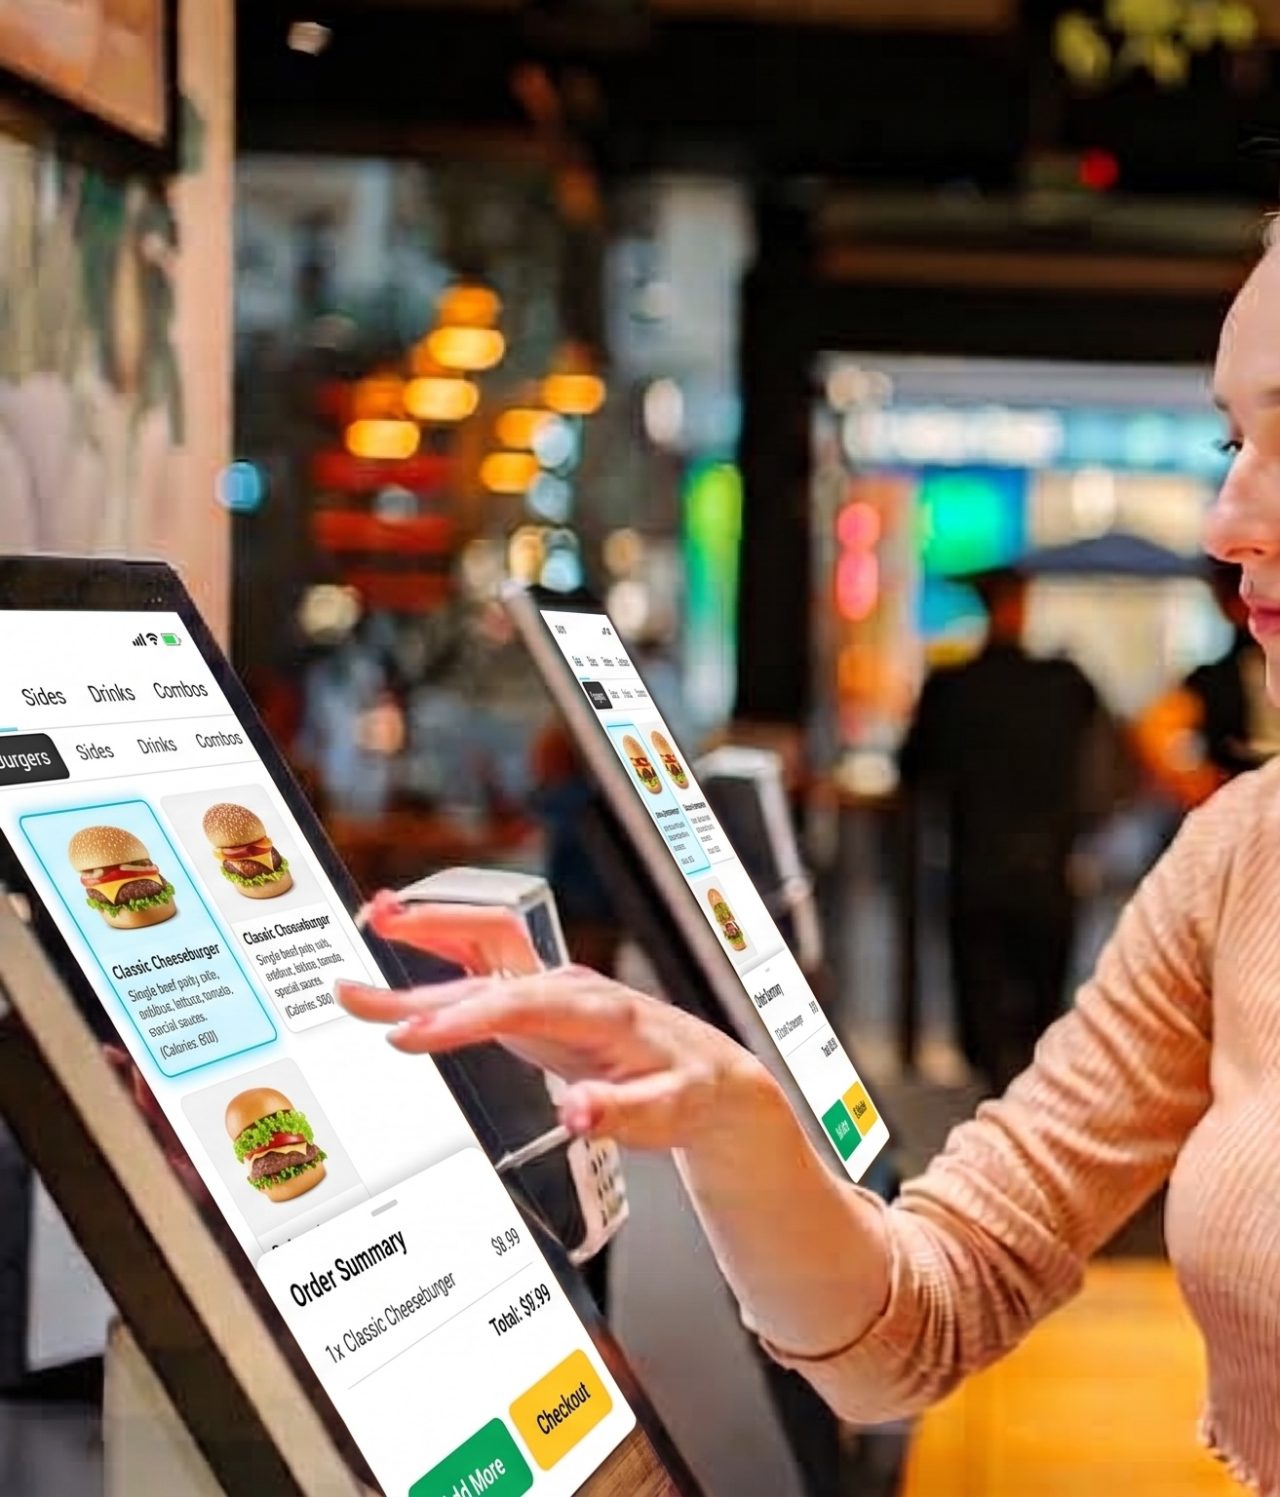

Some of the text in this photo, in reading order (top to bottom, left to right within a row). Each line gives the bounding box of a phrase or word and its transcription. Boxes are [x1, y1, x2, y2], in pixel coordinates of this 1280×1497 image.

[21, 680, 208, 706] Sides Drinks Combos
[76, 743, 115, 761] Sides
[137, 736, 178, 755] Drinks
[196, 731, 243, 749] Combos
[243, 927, 276, 945] Classic
[112, 944, 220, 980] Classic Cheeseburger
[128, 985, 158, 1002] Single
[491, 1227, 520, 1256] $8.99
[290, 1271, 337, 1307] Order
[335, 1231, 407, 1281] Summary
[325, 1272, 456, 1363] 1x Classic Cheeseburger
[489, 1305, 523, 1336] Total:
[536, 1382, 591, 1435] Checkout
[468, 1458, 506, 1496] More
